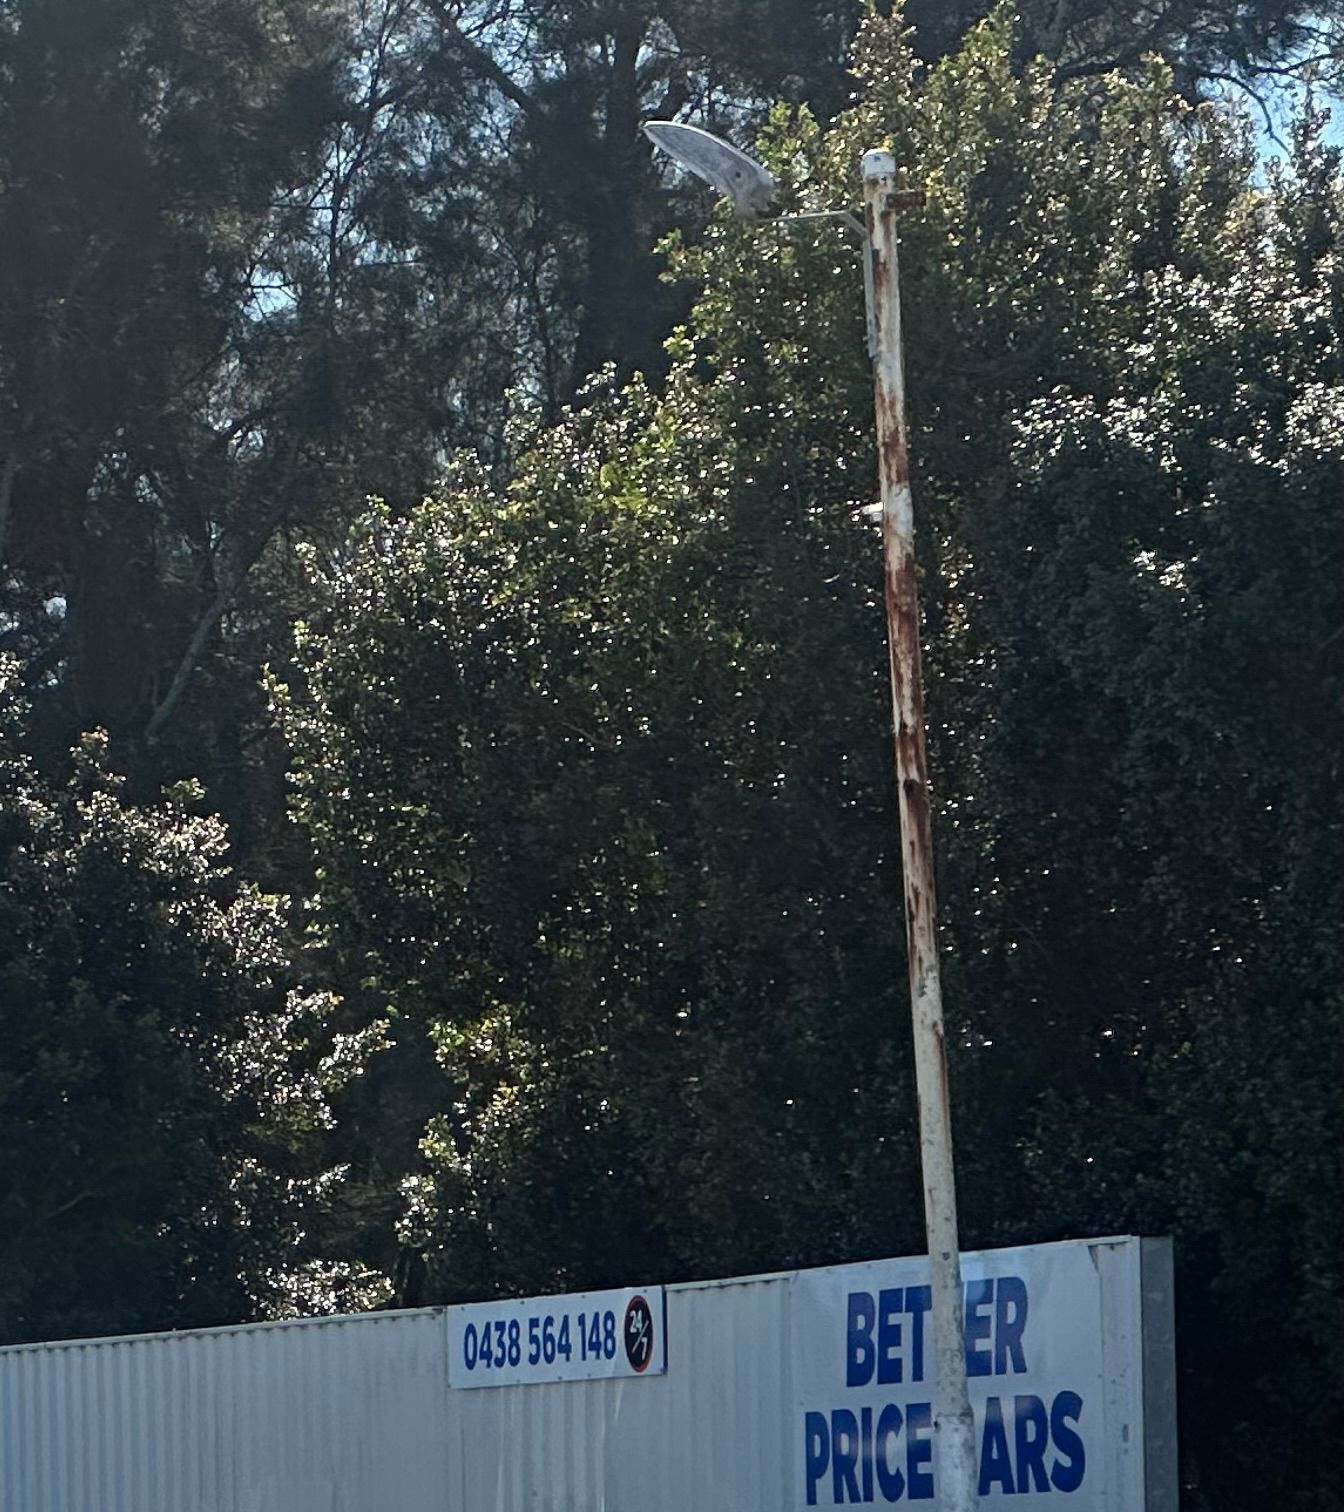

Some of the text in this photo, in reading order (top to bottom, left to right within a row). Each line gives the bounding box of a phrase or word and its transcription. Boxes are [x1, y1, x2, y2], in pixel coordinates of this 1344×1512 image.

[464, 1310, 616, 1370] 0438 564 148
[846, 1276, 1028, 1387] BETER
[805, 1390, 1086, 1505] PRICE ARS
